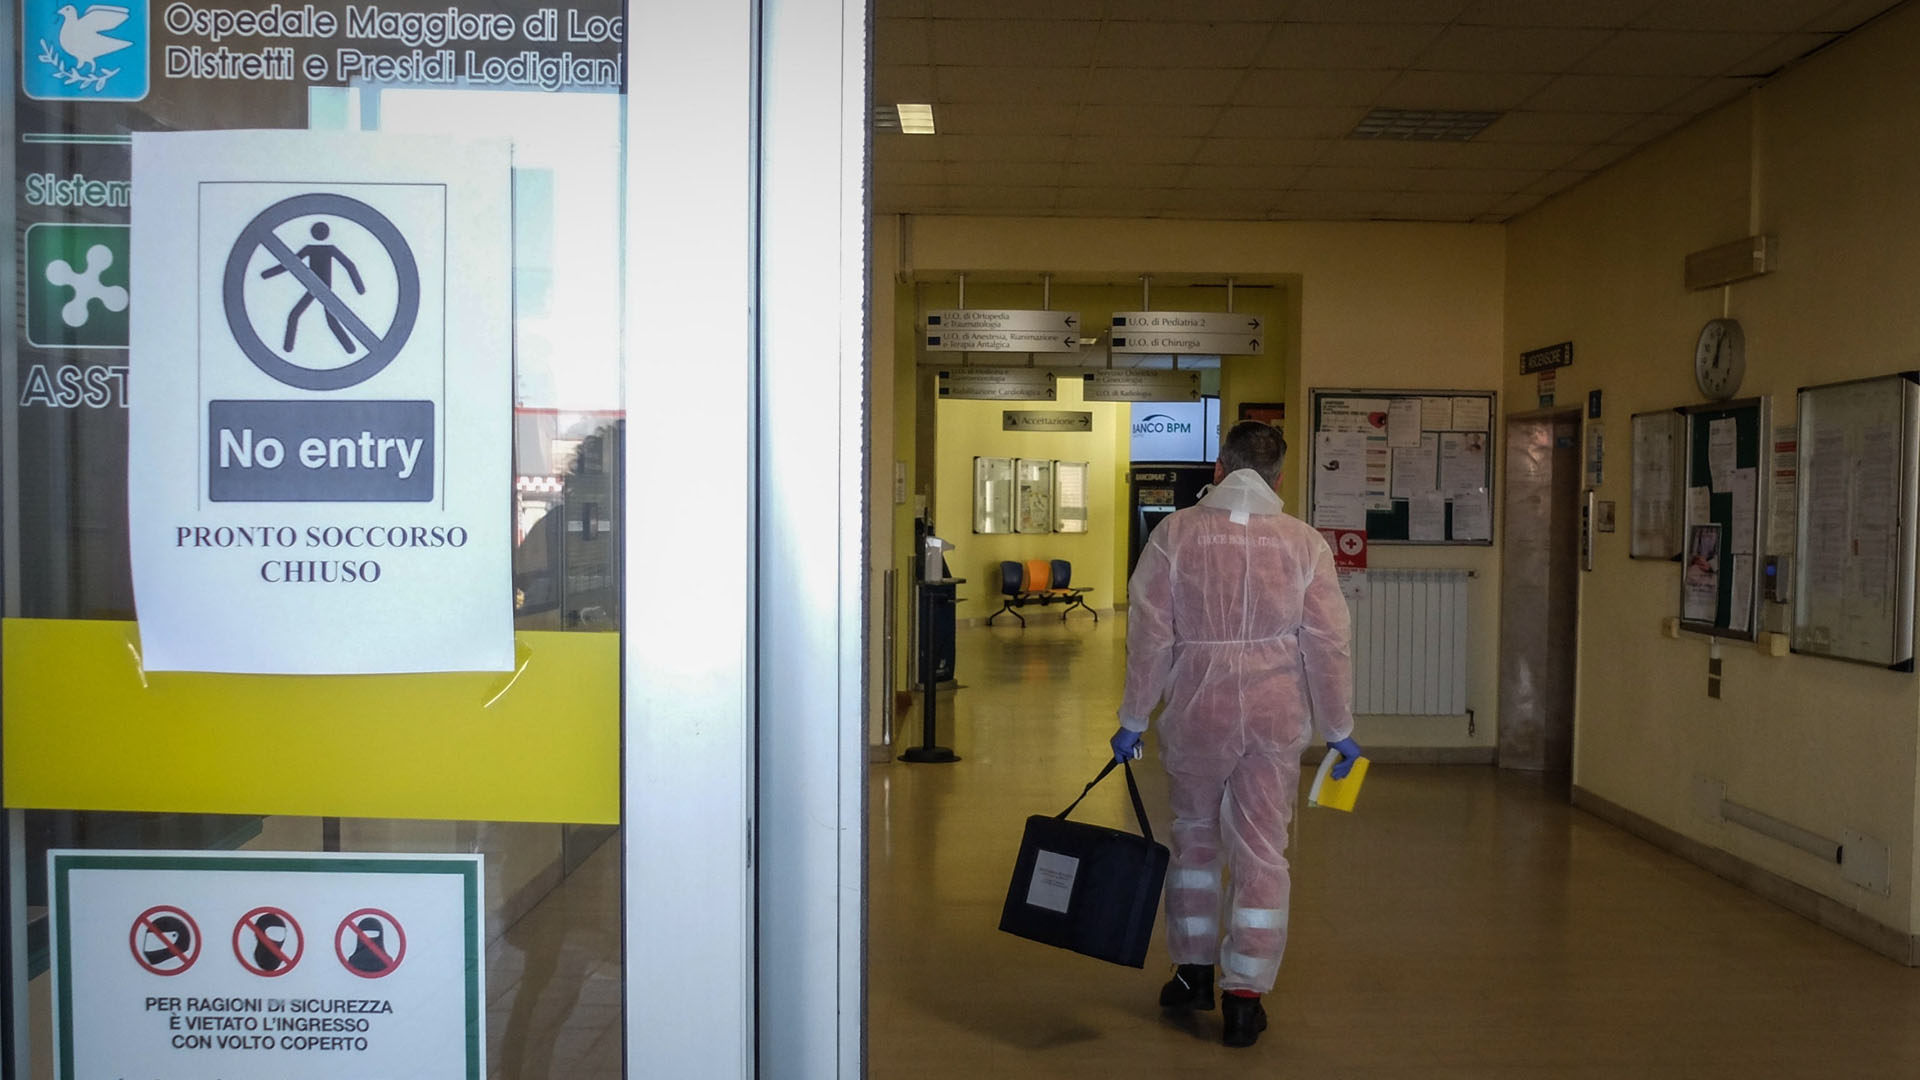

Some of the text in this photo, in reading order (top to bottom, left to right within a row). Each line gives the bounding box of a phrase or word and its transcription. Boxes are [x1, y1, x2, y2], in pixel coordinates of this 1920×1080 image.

[164, 2, 338, 41] Ospedale
[346, 4, 515, 47] Maggiore
[523, 8, 557, 41] di
[165, 46, 294, 80] Distretti
[303, 55, 329, 81] e
[337, 48, 455, 83] Presidi
[25, 172, 131, 207] Sistem
[950, 321, 1001, 329] Traumatologia
[963, 312, 971, 320] di
[972, 313, 1010, 322] Ortopedia
[1128, 317, 1206, 327] U.O. di Pediatria 2
[950, 341, 976, 349] Terapia
[977, 341, 1010, 349] Antalgica
[1128, 338, 1200, 349] U.O. di Chirurgia
[19, 364, 130, 408] ASST
[1020, 416, 1076, 425] Accettazione
[1166, 423, 1192, 433] BPM
[219, 428, 424, 479] No entry
[175, 526, 468, 548] PRONTO SOCCORSO
[260, 560, 381, 583] CHIUSO
[145, 997, 393, 1014] PER RAGIONI DI SICUREZZA
[170, 1013, 369, 1032] È VIETATO L'INGRESSO
[172, 1035, 368, 1051] CON VOLTO COPERTO
